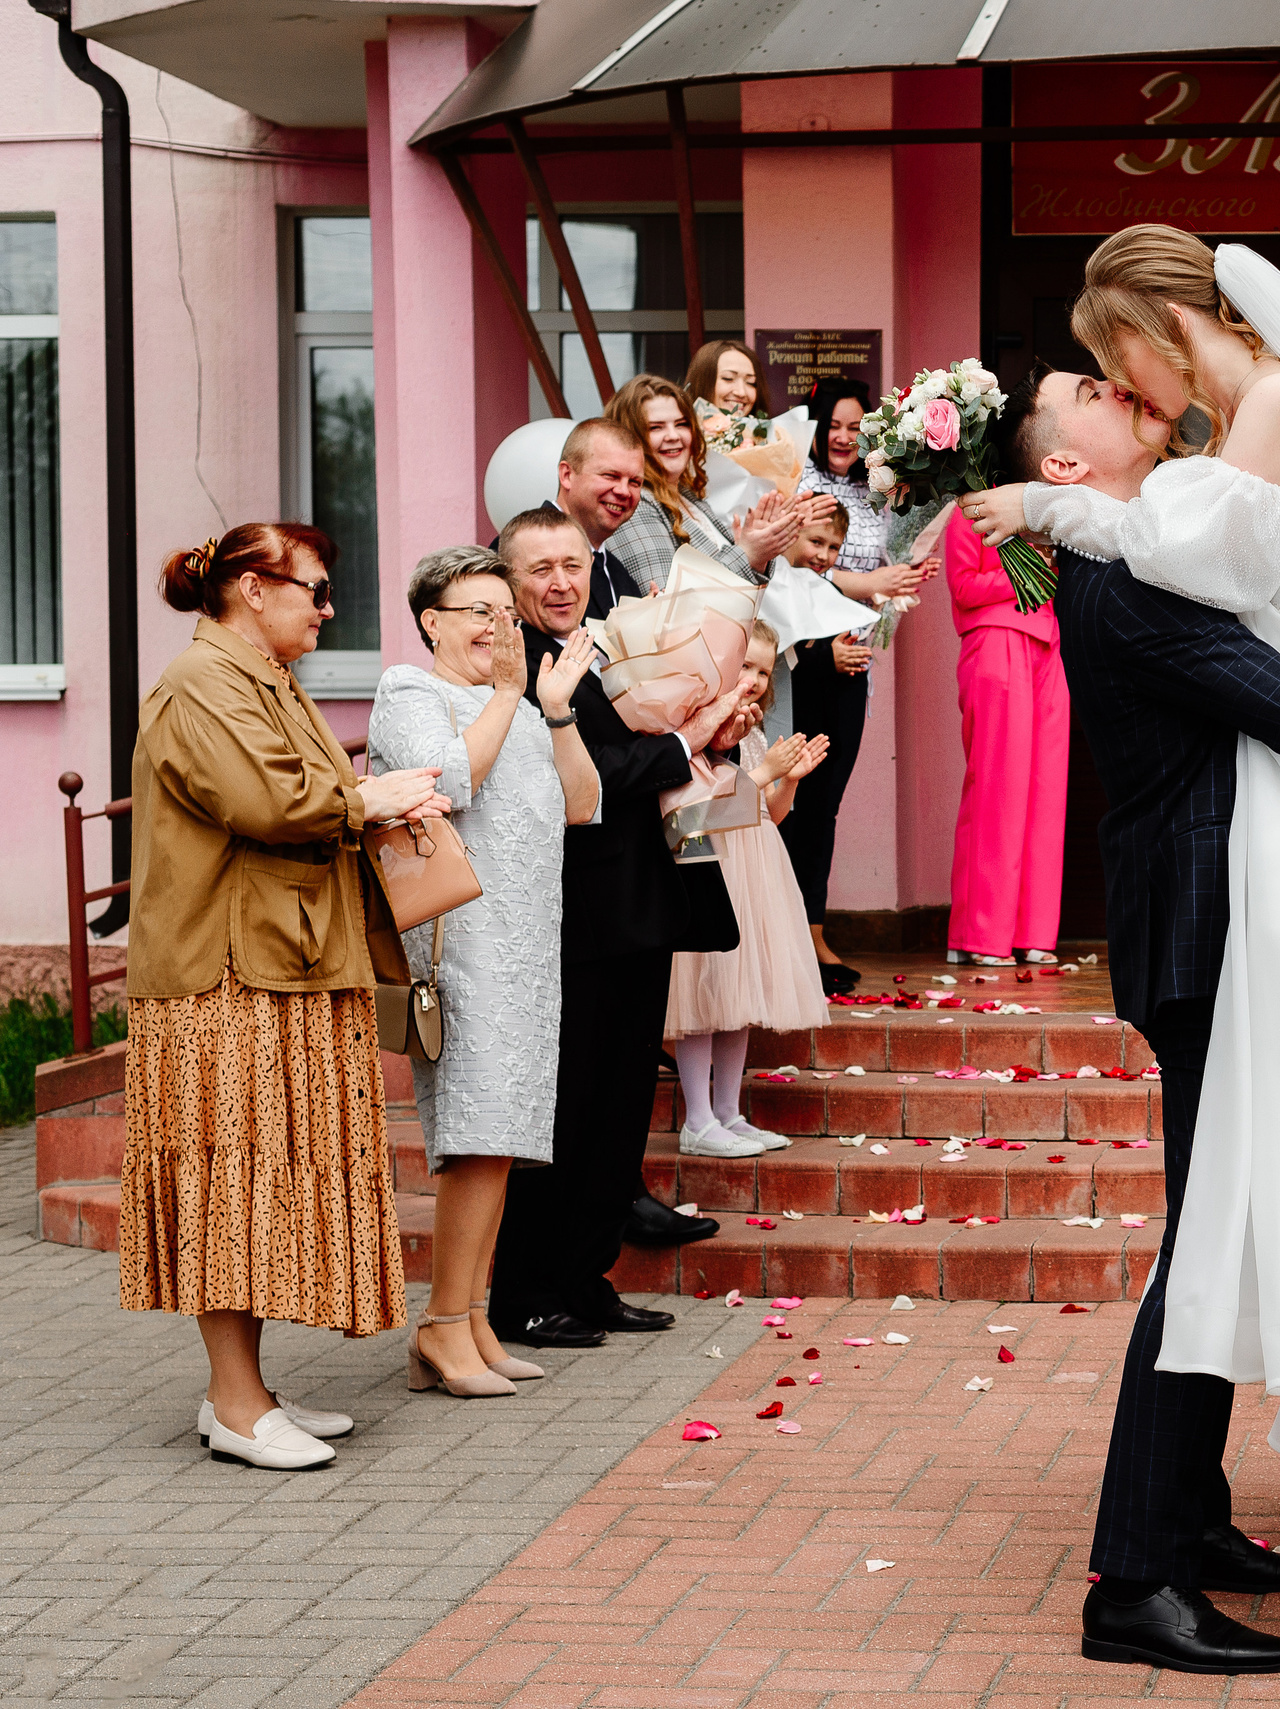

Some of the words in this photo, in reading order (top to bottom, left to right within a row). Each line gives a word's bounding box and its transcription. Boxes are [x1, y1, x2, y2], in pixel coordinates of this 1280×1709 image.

[1019, 184, 1257, 218] Жлобинского
[769, 350, 813, 365] Режим
[817, 350, 868, 365] работы:
